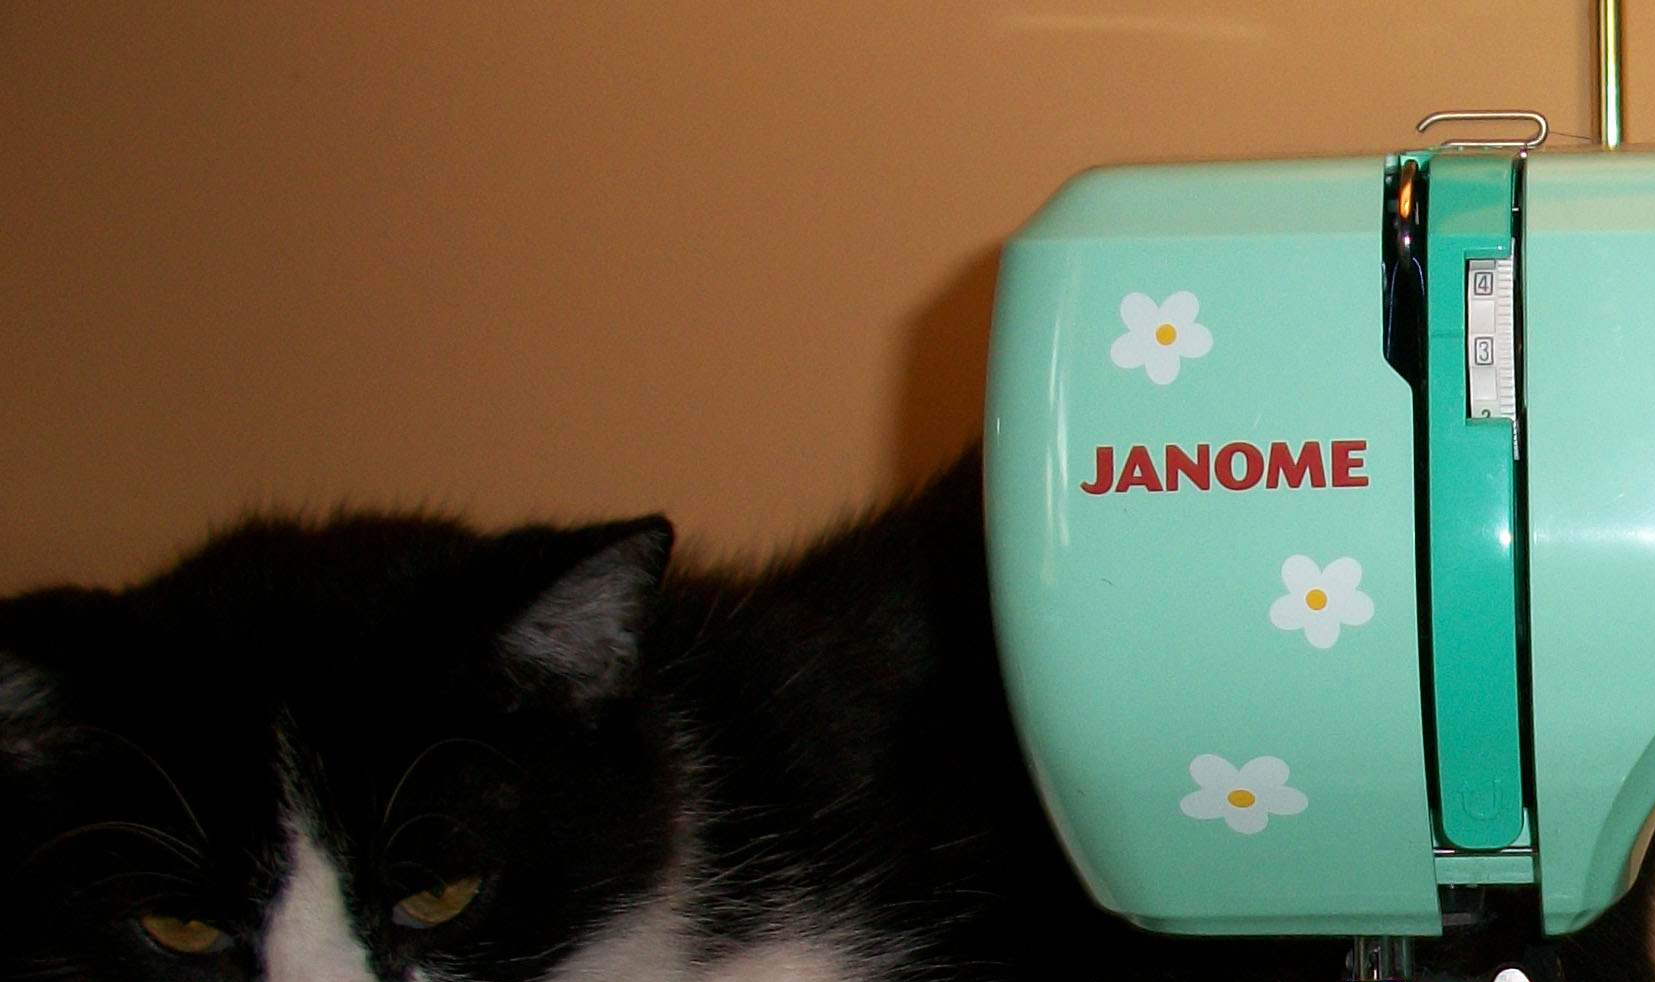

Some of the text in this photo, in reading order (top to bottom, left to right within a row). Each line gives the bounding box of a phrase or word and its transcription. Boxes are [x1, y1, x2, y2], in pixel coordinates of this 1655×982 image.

[1478, 274, 1489, 292] 4
[1479, 340, 1489, 361] 3
[1080, 440, 1369, 495] JANOME
